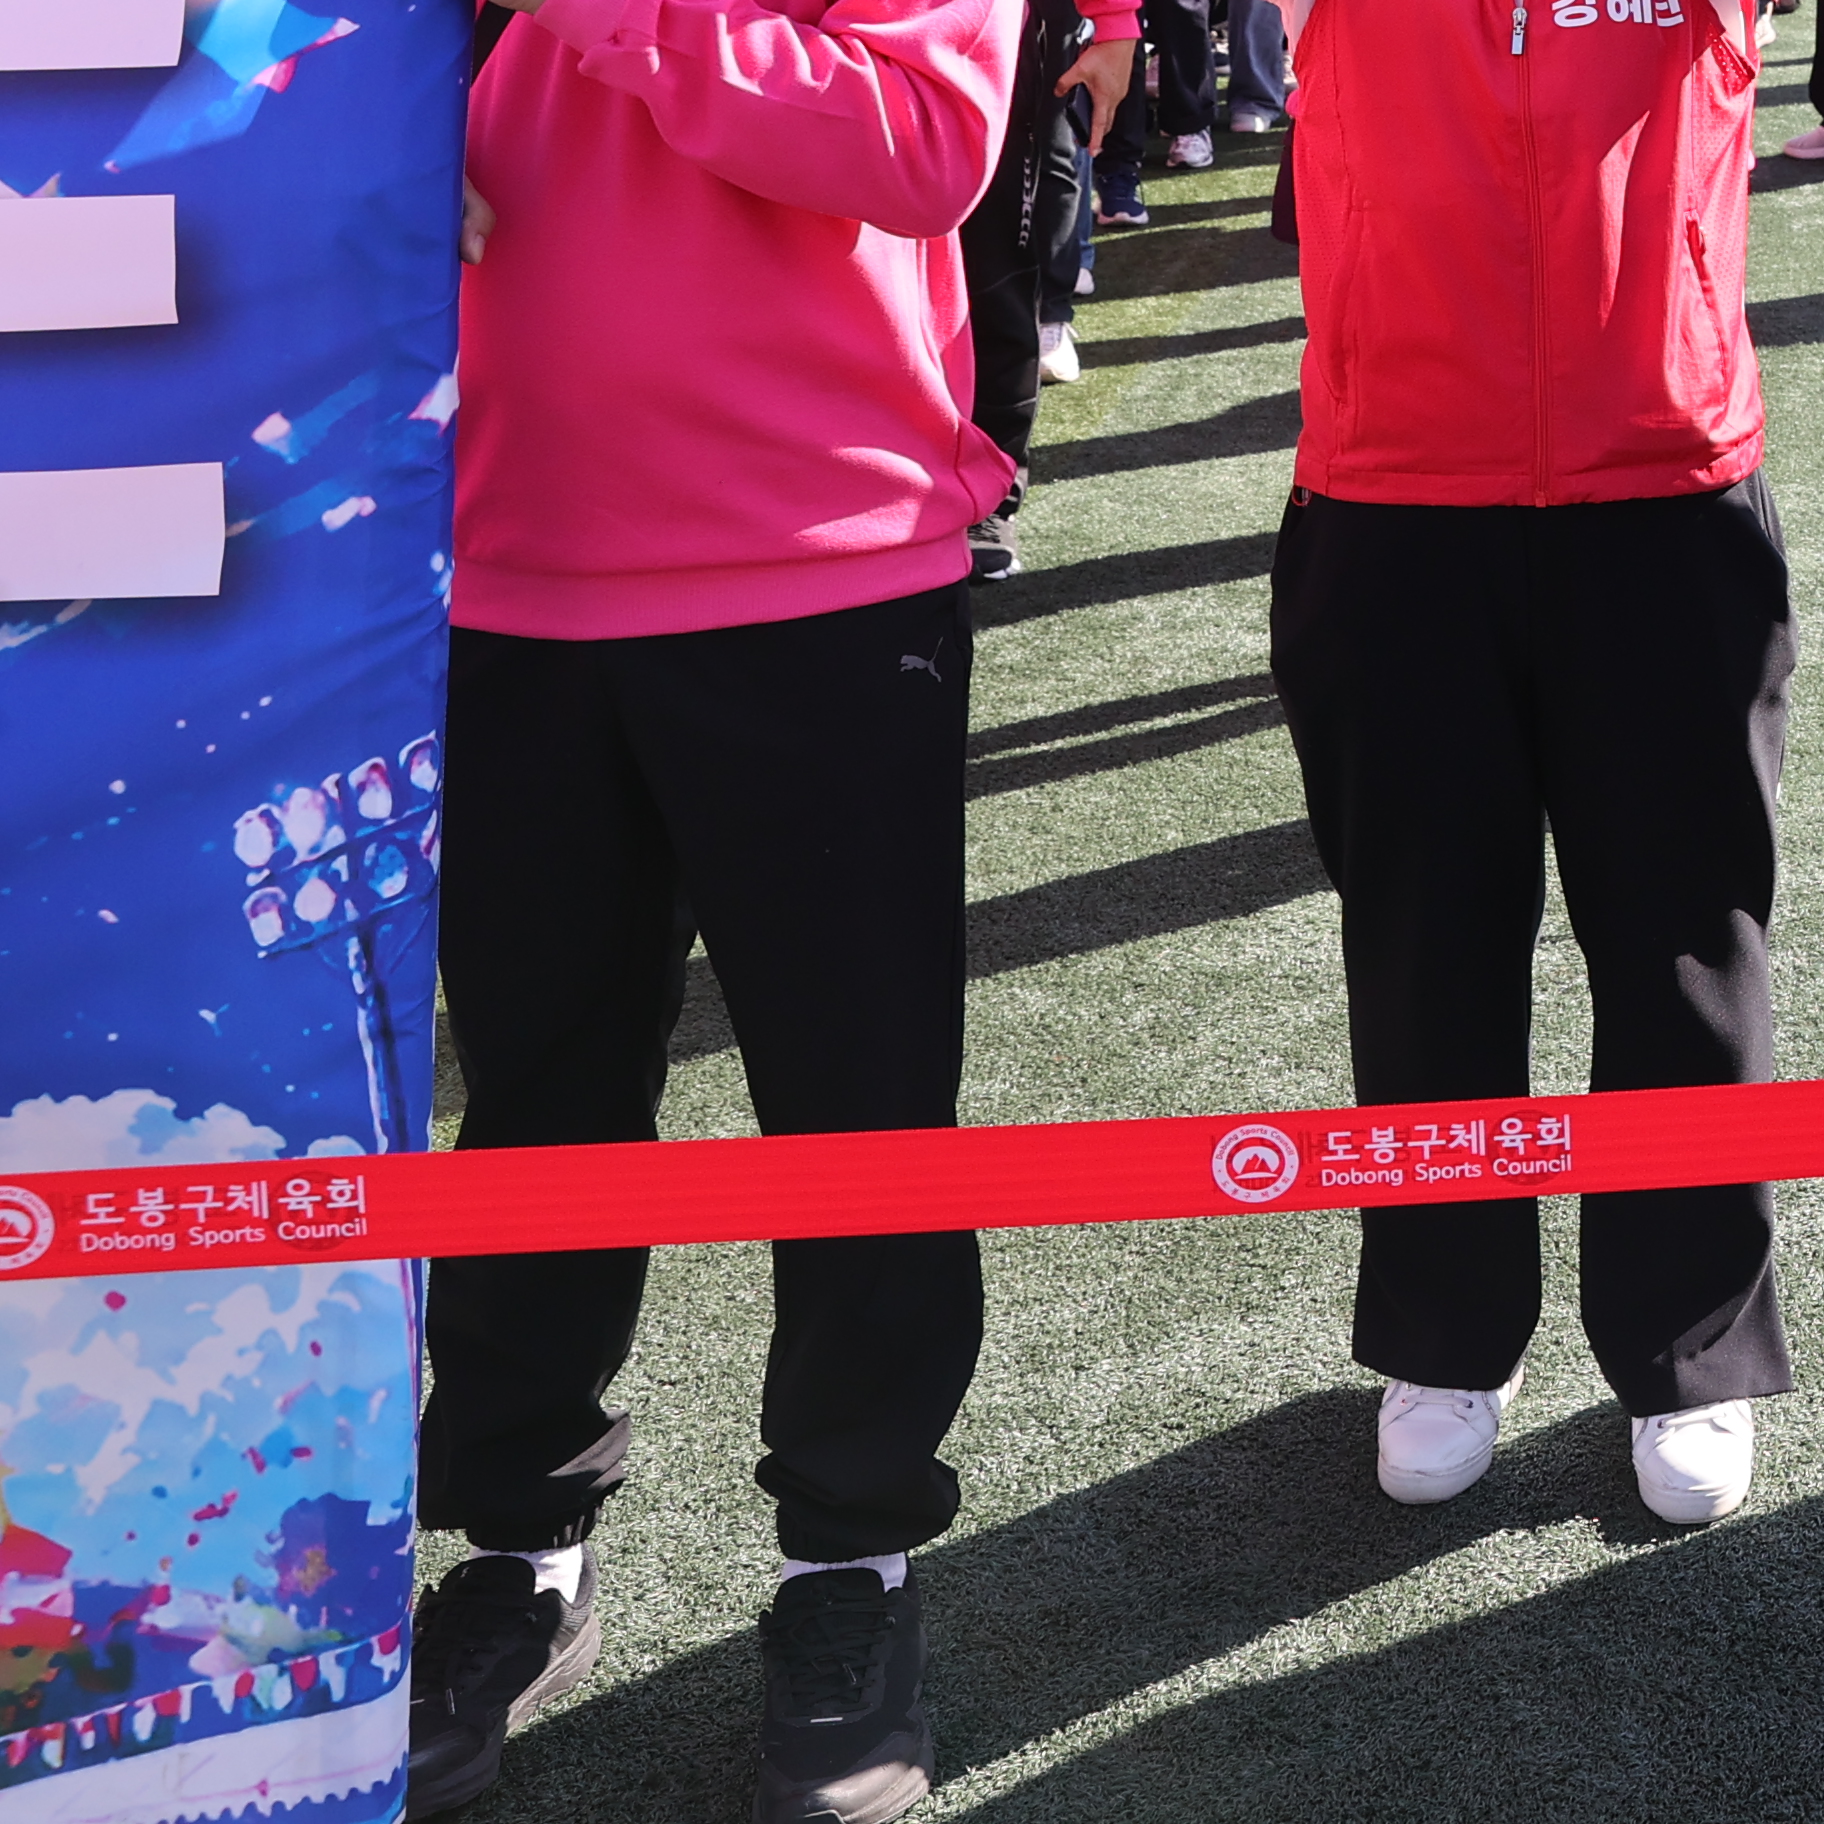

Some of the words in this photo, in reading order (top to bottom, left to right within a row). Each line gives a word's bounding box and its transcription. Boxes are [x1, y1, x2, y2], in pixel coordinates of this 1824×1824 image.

[1320, 1114, 1572, 1165] 도봉구체육회
[1321, 1166, 1404, 1188] Dobong
[1415, 1160, 1482, 1184] Sports
[1492, 1154, 1572, 1177] Council
[80, 1176, 366, 1228] 도봉구체육회
[80, 1232, 177, 1254] Dobong
[188, 1224, 266, 1248] Sports
[277, 1218, 368, 1242] Council
